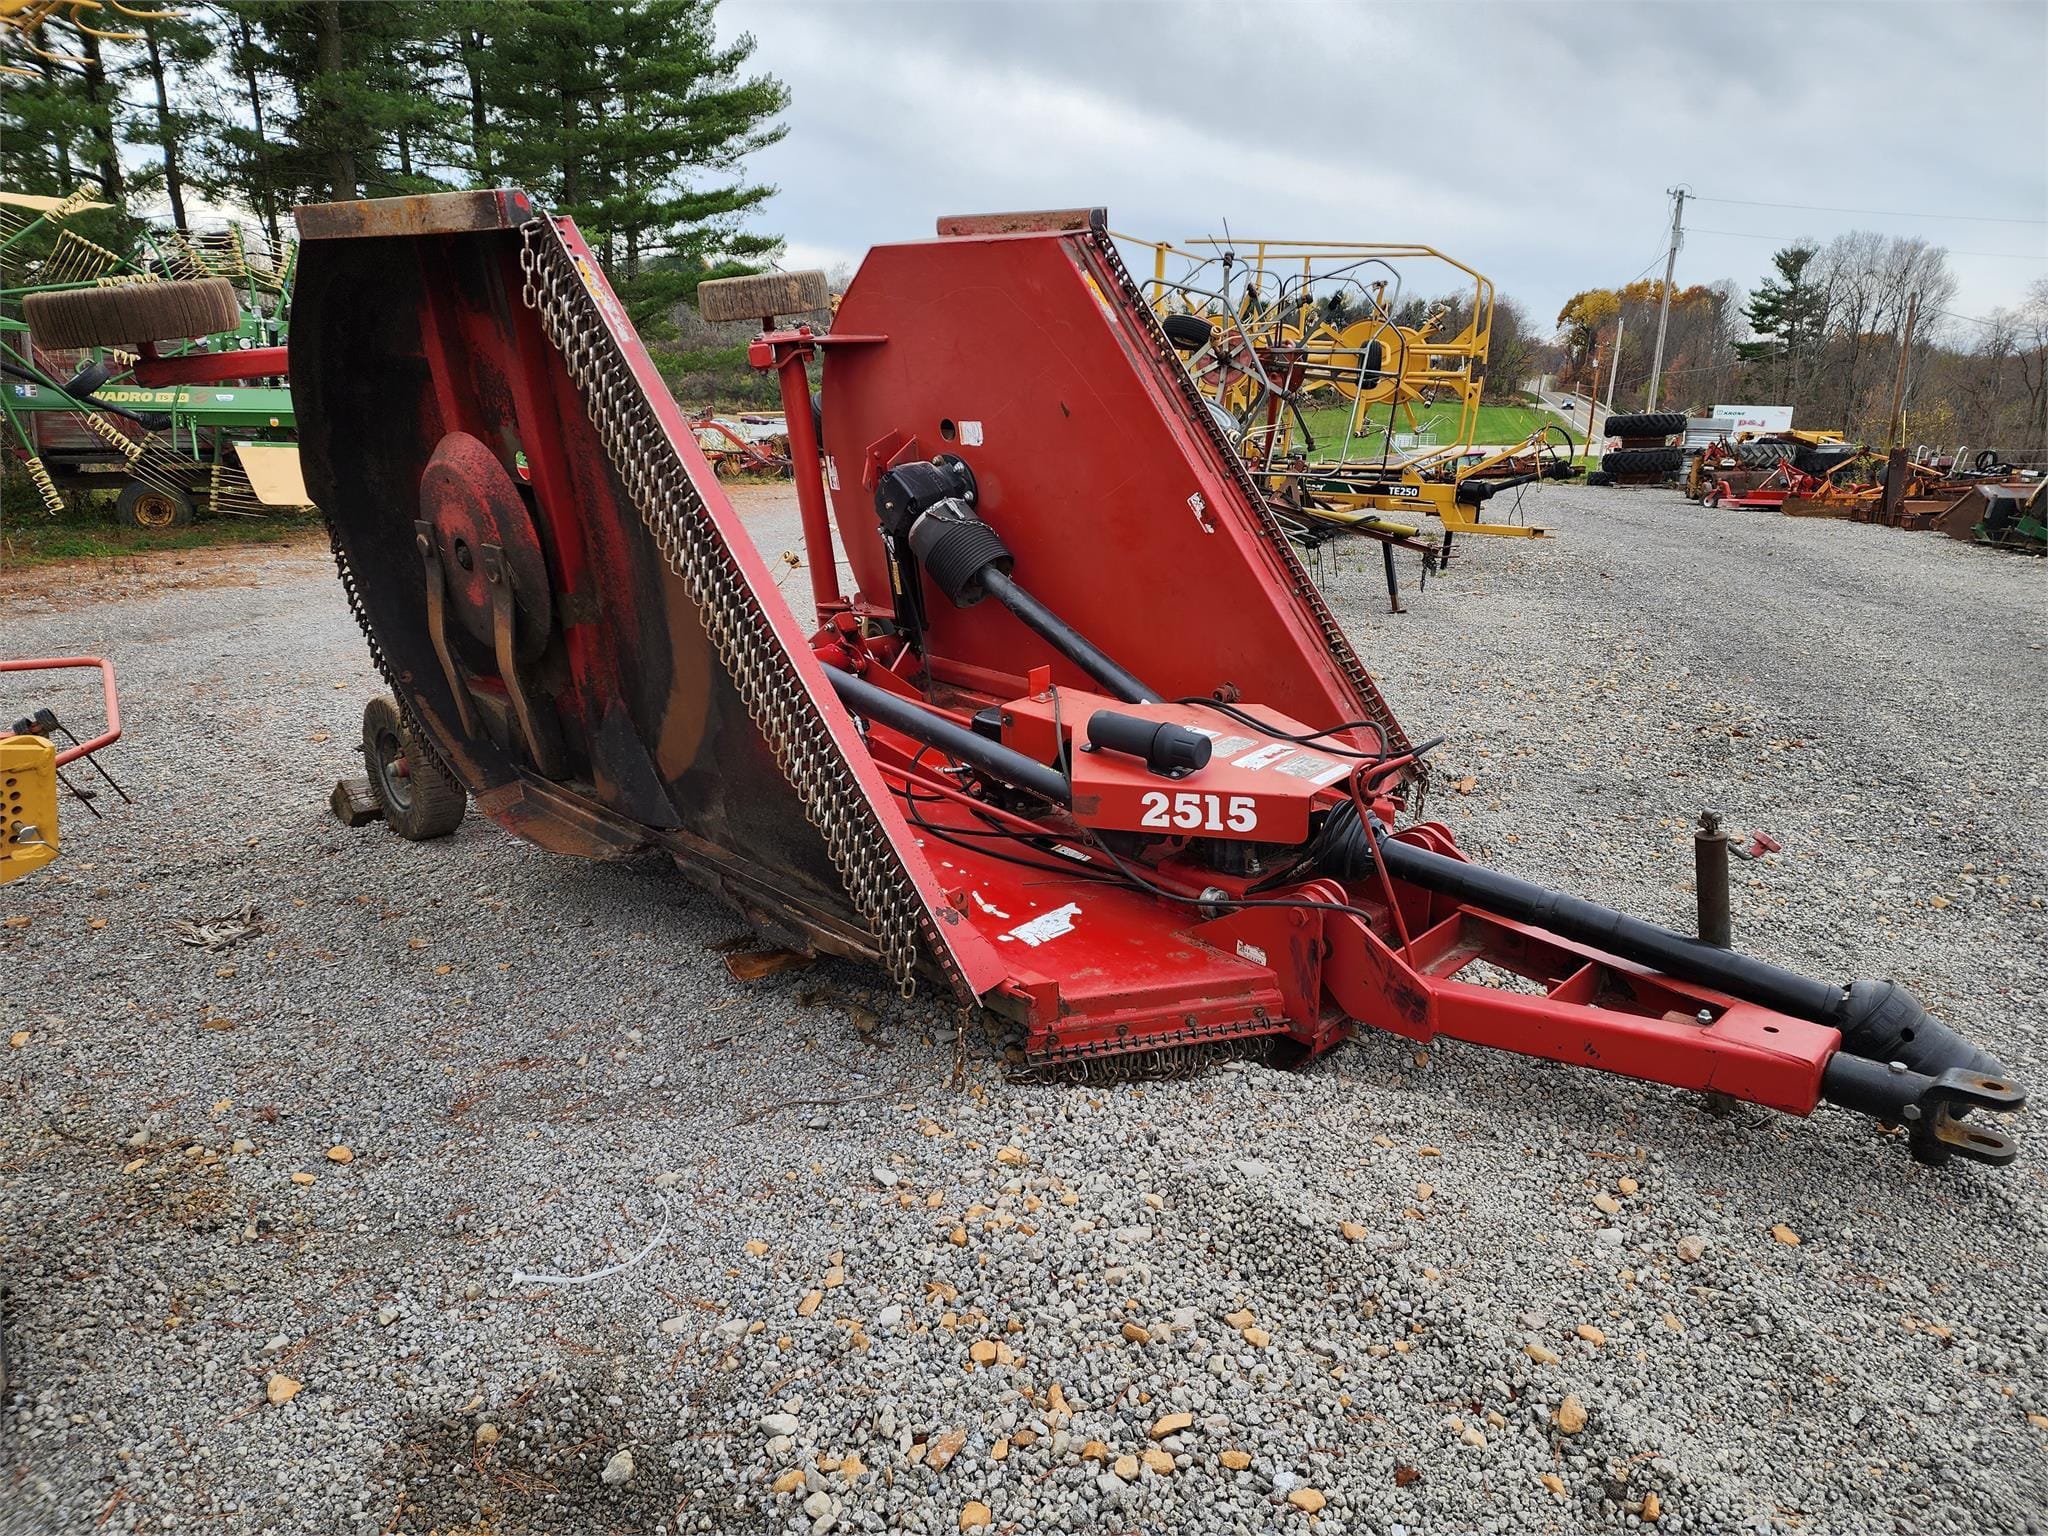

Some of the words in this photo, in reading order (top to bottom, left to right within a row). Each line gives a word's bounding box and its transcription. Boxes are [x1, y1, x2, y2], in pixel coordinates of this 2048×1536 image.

[89, 391, 153, 402] WADRO
[1388, 486, 1418, 497] TE250
[1140, 791, 1258, 832] 2515
